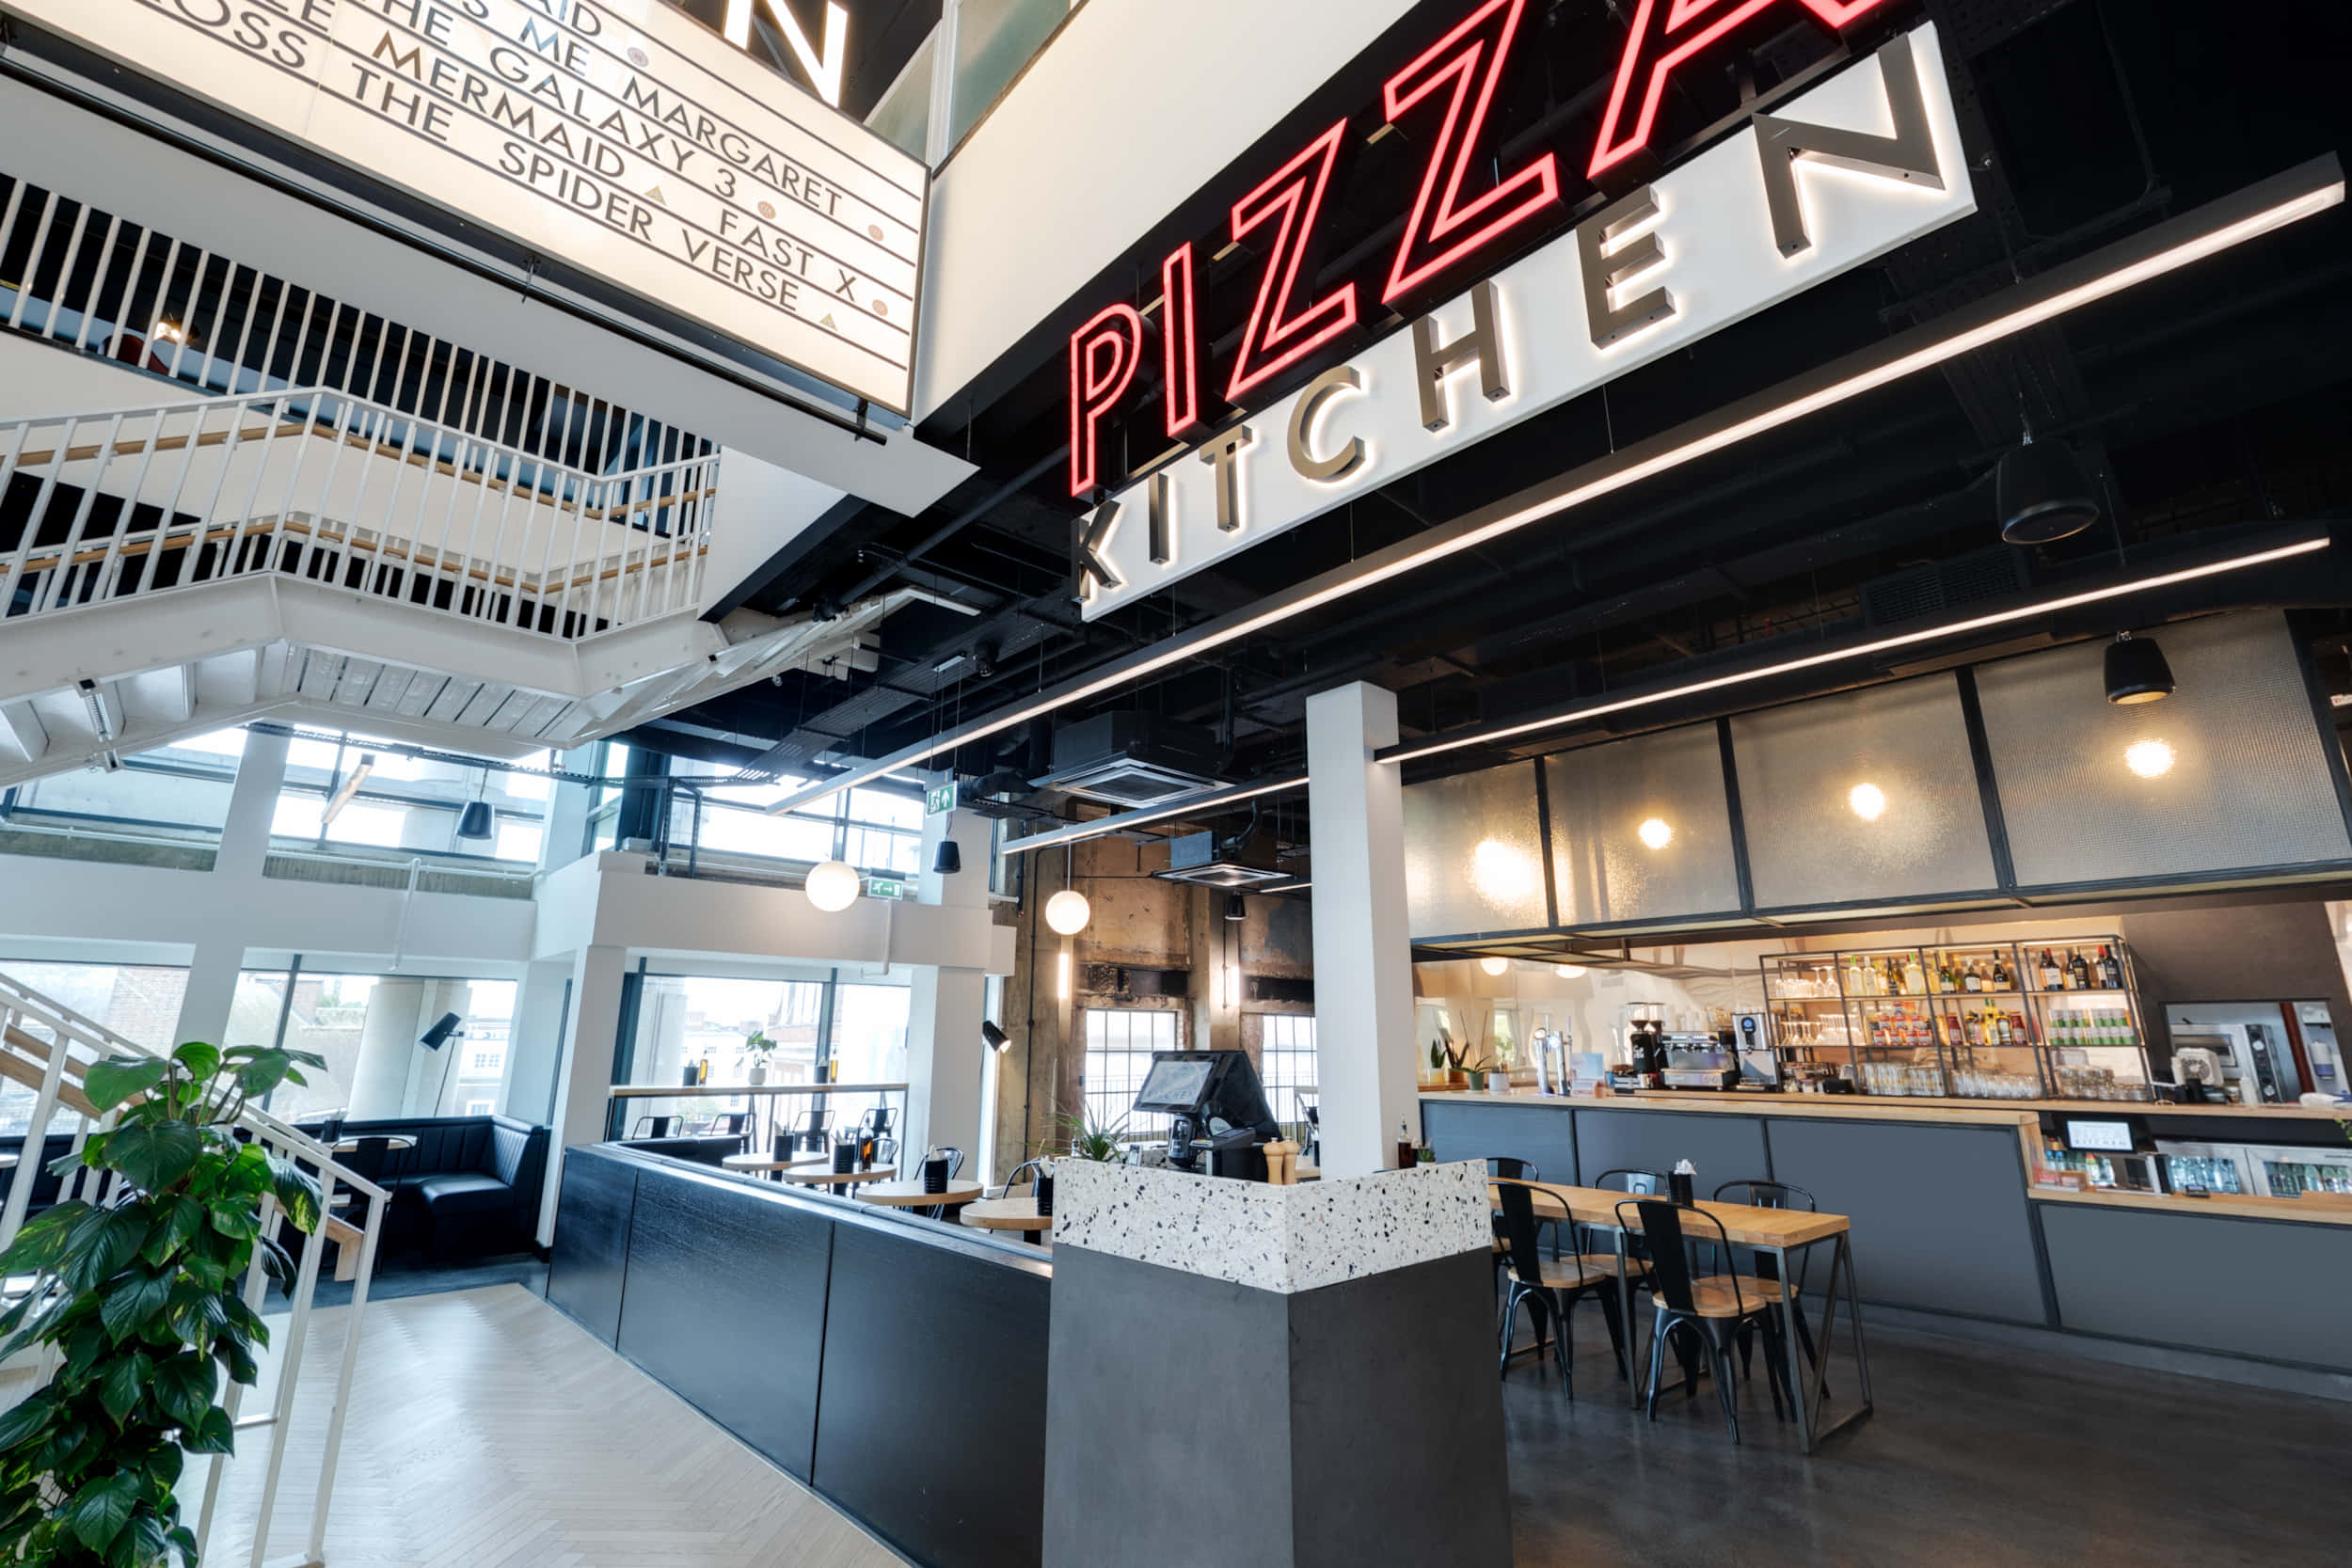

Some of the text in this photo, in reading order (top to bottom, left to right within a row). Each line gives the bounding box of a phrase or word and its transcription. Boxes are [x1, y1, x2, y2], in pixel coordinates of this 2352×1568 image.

[152, 0, 799, 312] OSS THE SPIDER VERSE
[361, 0, 454, 46] HE
[489, 46, 696, 171] GALAXY
[714, 167, 737, 198] 3
[372, 29, 626, 178] MERMAID
[518, 16, 591, 77] ME
[622, 75, 842, 216] MARGARET
[719, 208, 858, 302] FAST X
[1071, 31, 1947, 603] KITCHEN
